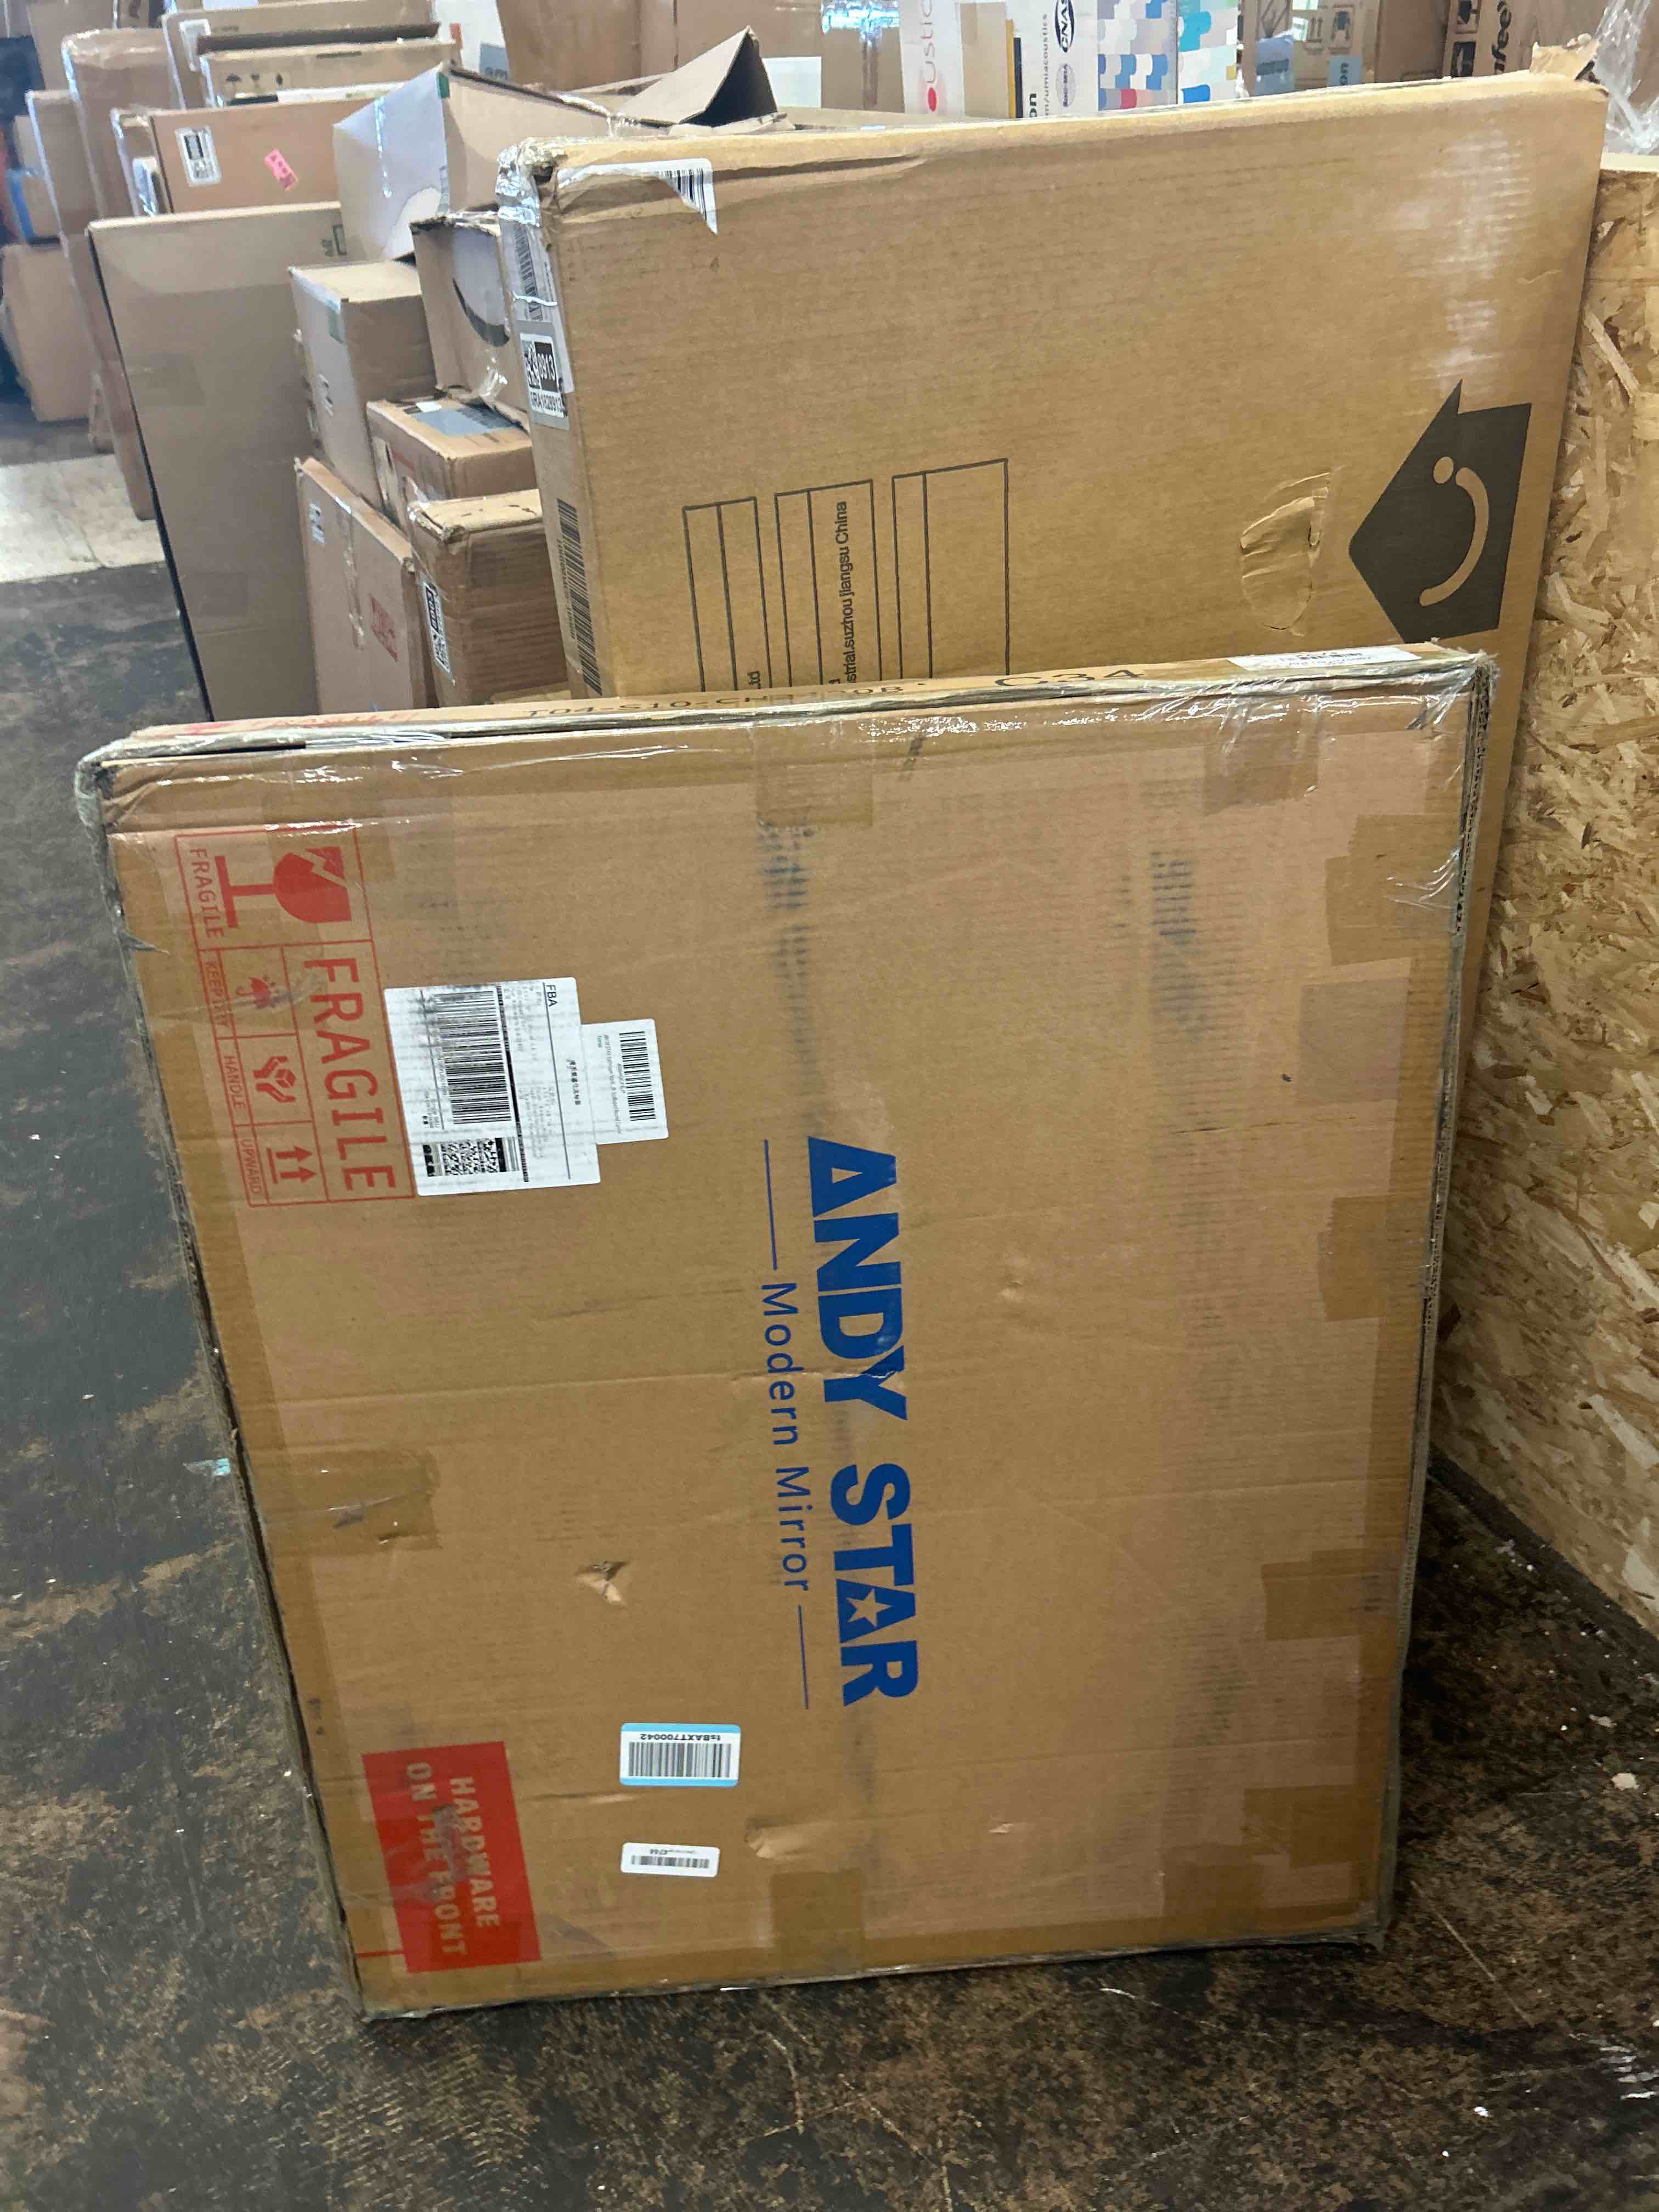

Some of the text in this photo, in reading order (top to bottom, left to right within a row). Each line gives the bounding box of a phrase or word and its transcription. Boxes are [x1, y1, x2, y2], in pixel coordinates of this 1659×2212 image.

[834, 501, 849, 544] China
[839, 546, 854, 597] jiangsu
[191, 848, 224, 939] FRAGILE
[546, 985, 557, 1007] FBA
[223, 1055, 246, 1109] HANDLE
[303, 958, 396, 1191] FRAGILE
[240, 1139, 262, 1195] UPWARD
[761, 1282, 813, 1592] Modern Mirror
[807, 1135, 919, 1708] ANDY STAR
[407, 1762, 437, 1801] ON
[427, 1870, 467, 1955] FRONT
[449, 1776, 501, 1928] HARDWARE
